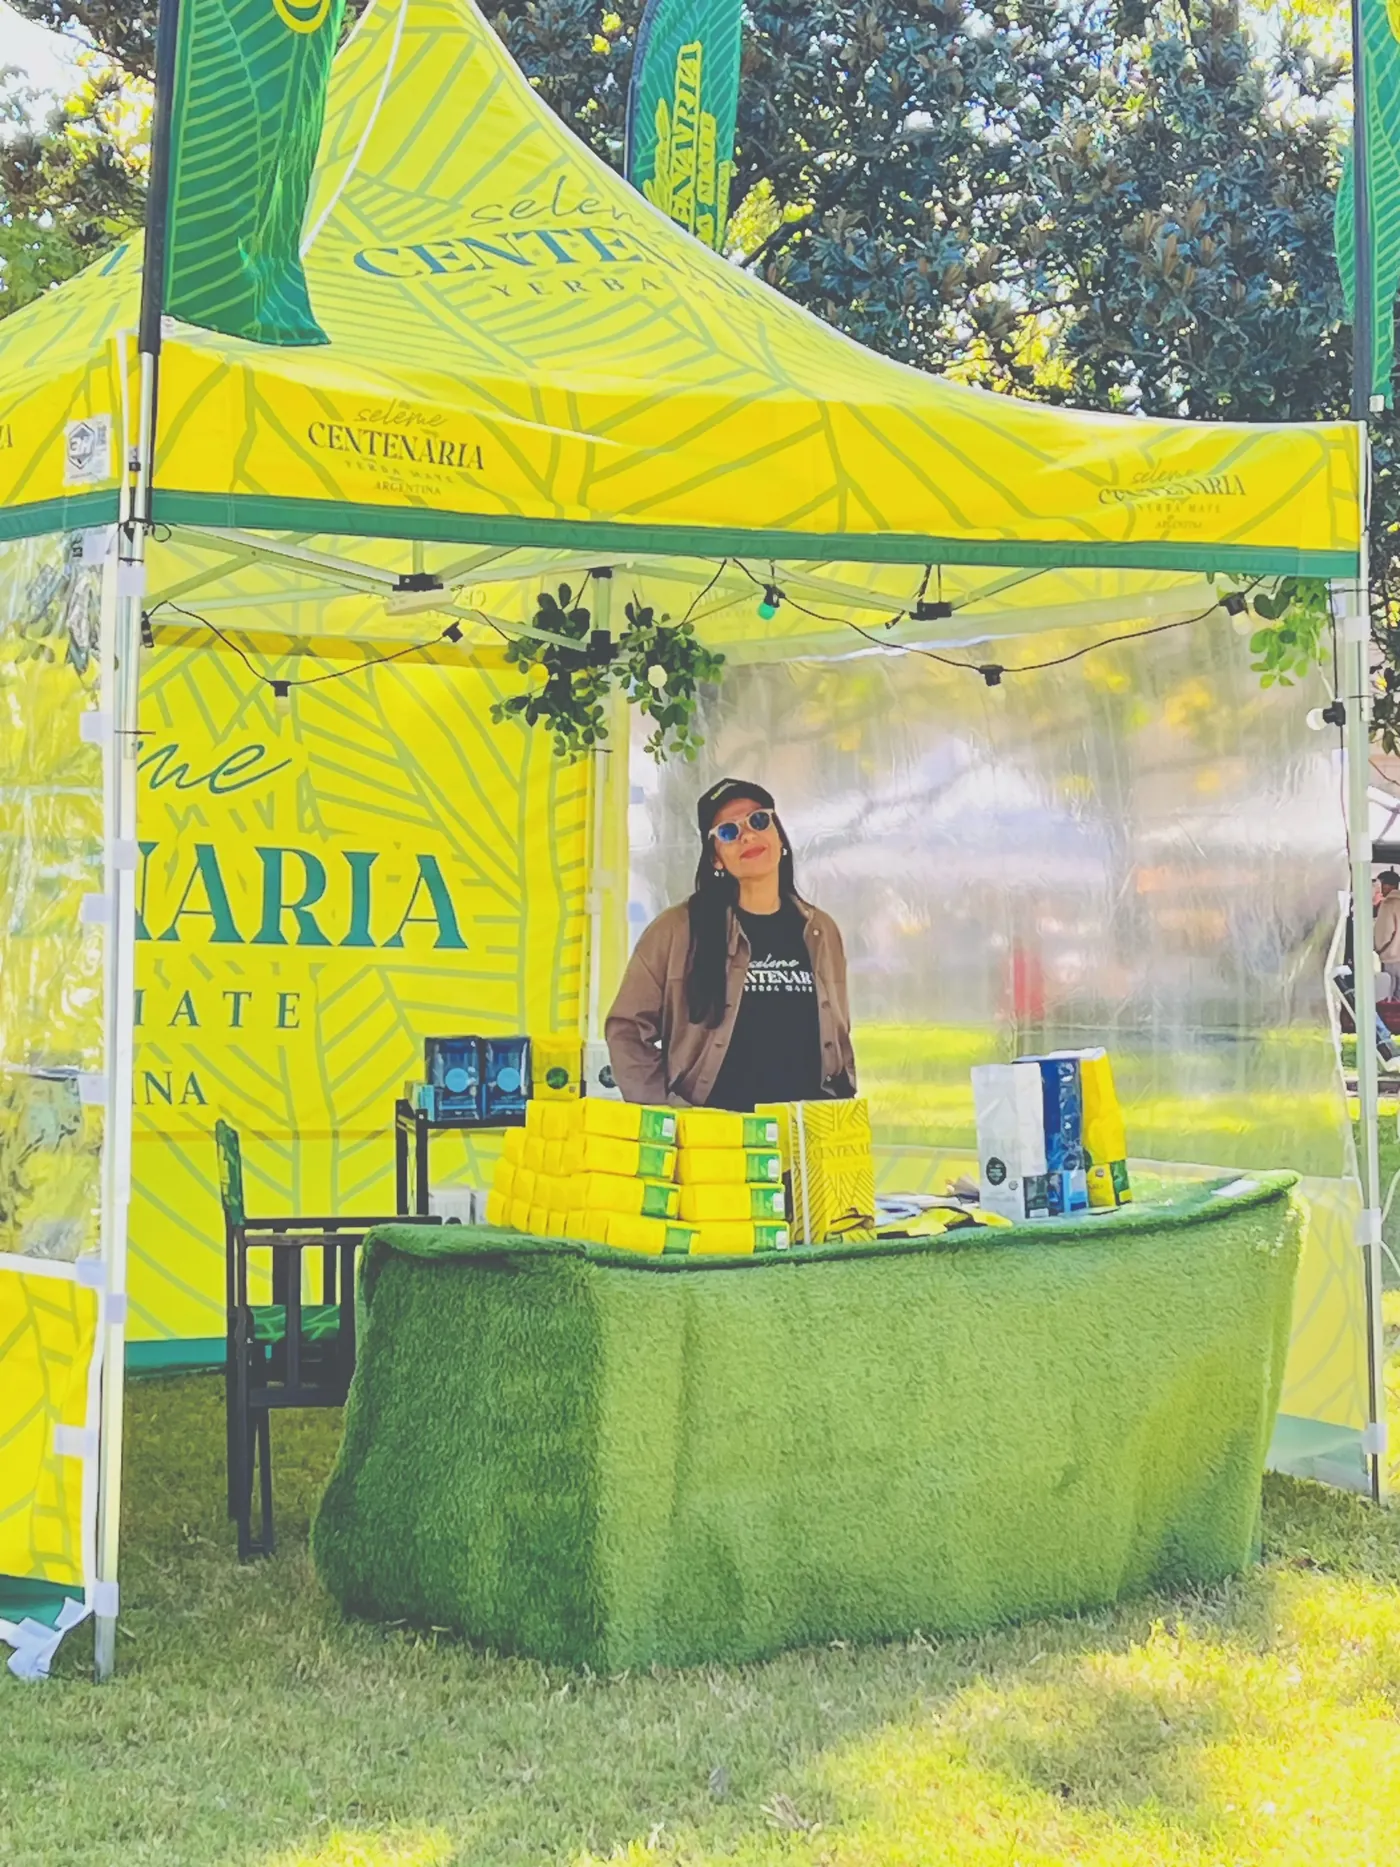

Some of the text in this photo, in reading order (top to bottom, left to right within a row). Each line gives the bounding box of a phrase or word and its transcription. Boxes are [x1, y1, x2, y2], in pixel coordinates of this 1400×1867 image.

[489, 277, 663, 298] YERBA
[308, 421, 485, 471] CENTENARIA
[375, 480, 442, 496] ARGENTINA
